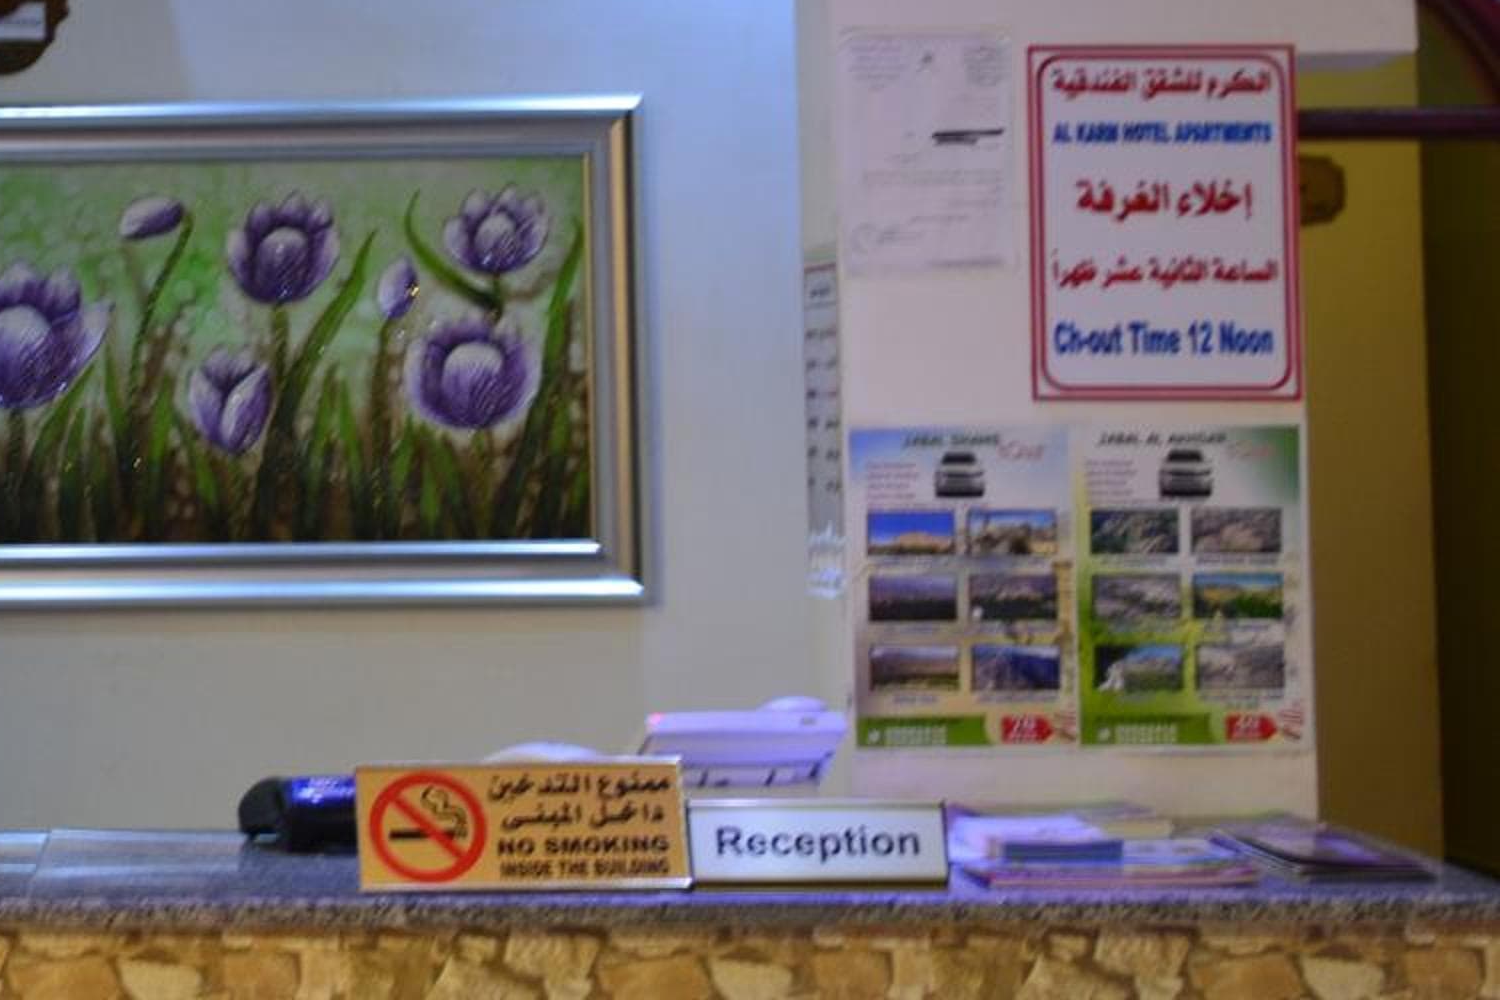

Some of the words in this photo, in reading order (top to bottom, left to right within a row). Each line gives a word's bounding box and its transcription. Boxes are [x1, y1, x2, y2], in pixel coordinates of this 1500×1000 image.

[1053, 121, 1071, 142] AL
[1123, 121, 1171, 143] HOTEL
[1075, 179, 1170, 222] الغرفة
[1149, 255, 1207, 290] الثانية
[1212, 256, 1278, 282] الساعة
[1054, 320, 1123, 355] Ch-out
[1127, 320, 1181, 355] Time
[1187, 319, 1214, 354] 12
[1218, 320, 1274, 355] Noon
[488, 772, 591, 803] التدخين
[597, 770, 670, 800] ممنوع
[590, 801, 665, 829] داخل
[497, 837, 535, 855] NO
[544, 835, 670, 855] SMOKING
[716, 824, 921, 865] Reception
[501, 861, 551, 877] INSIDE
[559, 860, 589, 876] THE
[594, 858, 670, 876] BUILDING
